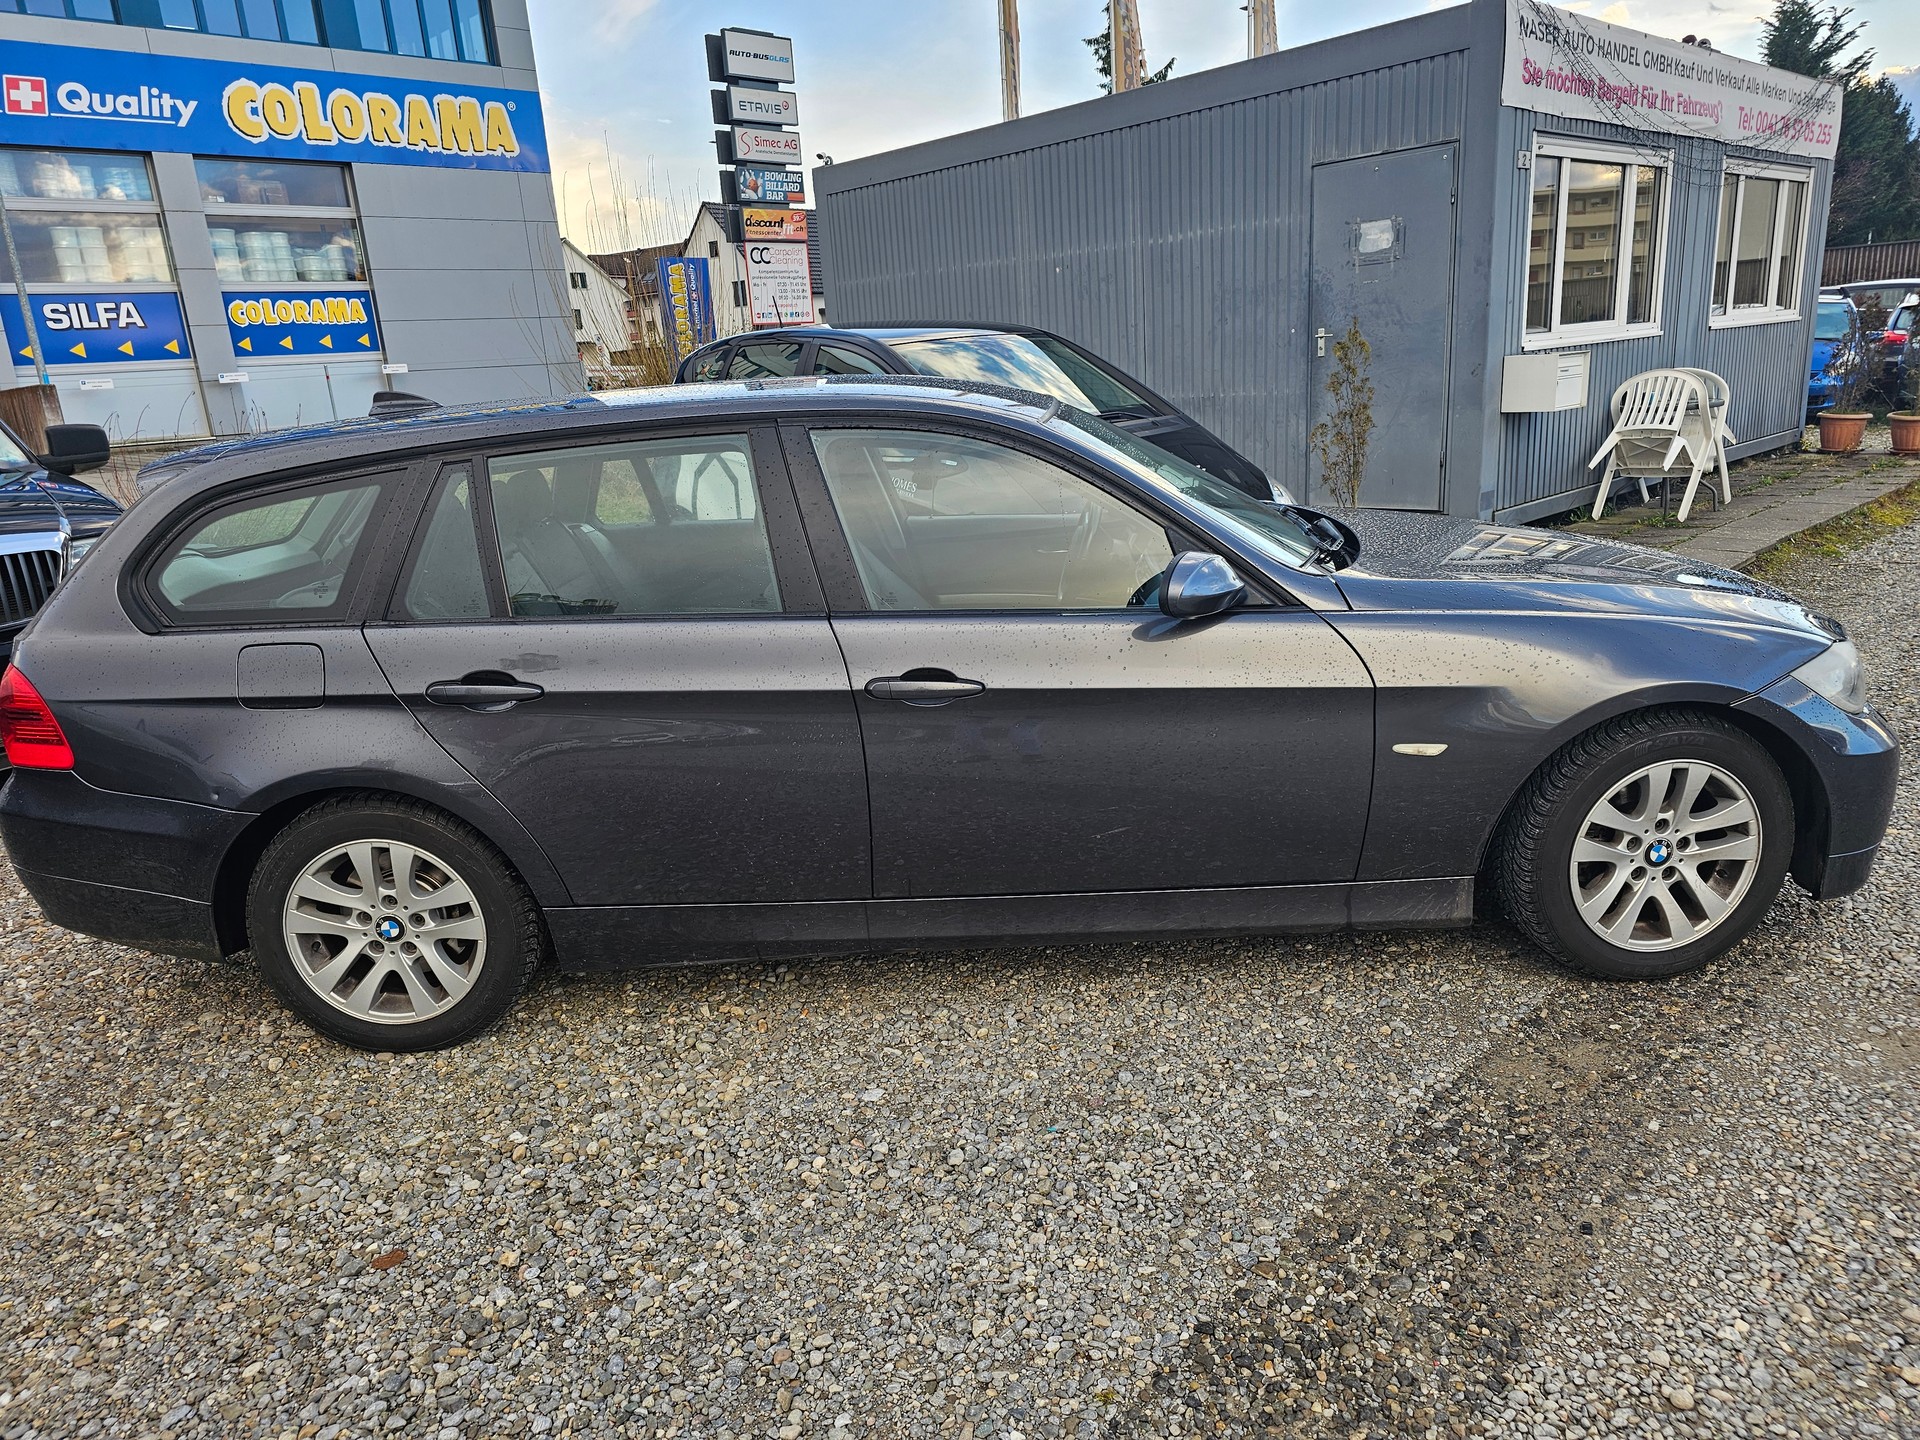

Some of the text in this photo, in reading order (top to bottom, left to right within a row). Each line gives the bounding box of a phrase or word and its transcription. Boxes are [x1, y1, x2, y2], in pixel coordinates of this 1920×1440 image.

[729, 50, 790, 63] AUTO-BUSGLAS
[1519, 15, 1560, 46] NASER
[1562, 28, 1595, 55] AUTO
[1597, 38, 1641, 67] HANDEL
[1643, 49, 1673, 76] GMBH
[1674, 57, 1696, 80] Kauf
[1696, 63, 1714, 84] Und
[1715, 70, 1746, 91] Verkauf
[1746, 76, 1760, 95] Alle
[1761, 81, 1787, 101] Marken
[1788, 87, 1802, 105] Und
[1521, 57, 1543, 87] Sie
[1544, 66, 1596, 98] möchten
[1597, 76, 1639, 109] Bargeld
[1641, 84, 1659, 109] Für
[1660, 90, 1675, 112] Ihr
[56, 81, 199, 128] Quality
[738, 101, 782, 114] ETAVIS
[1738, 105, 1755, 132] Tel:
[1815, 122, 1833, 146] 255
[754, 136, 798, 150] Simec AG
[1522, 153, 1527, 167] 2
[764, 171, 802, 183] BOWLING
[765, 181, 800, 192] BILLARD
[766, 191, 784, 201] BAR
[769, 256, 803, 267] Cleaning
[42, 302, 146, 330] SILFA
[891, 476, 918, 493] OMES
